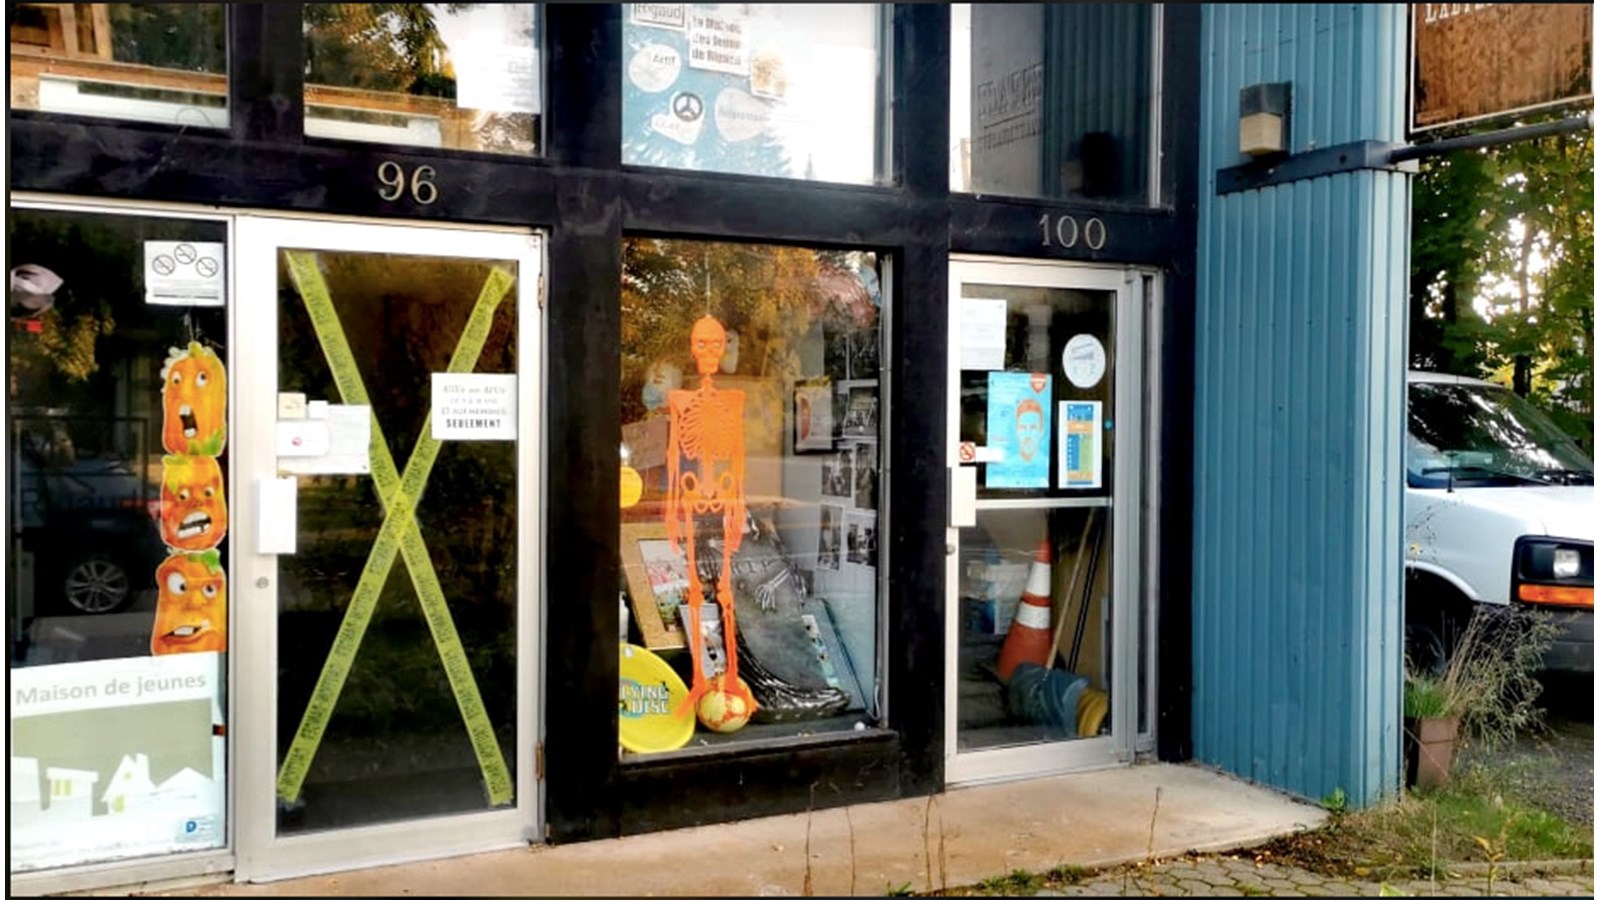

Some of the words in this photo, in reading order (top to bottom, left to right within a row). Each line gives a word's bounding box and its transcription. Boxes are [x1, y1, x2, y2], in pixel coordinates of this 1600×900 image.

[378, 161, 438, 204] 96
[1040, 214, 1106, 250] 100
[446, 418, 501, 428] SEULEMENT
[15, 685, 98, 705] Maison
[104, 679, 131, 696] de
[137, 674, 206, 697] jeunes
